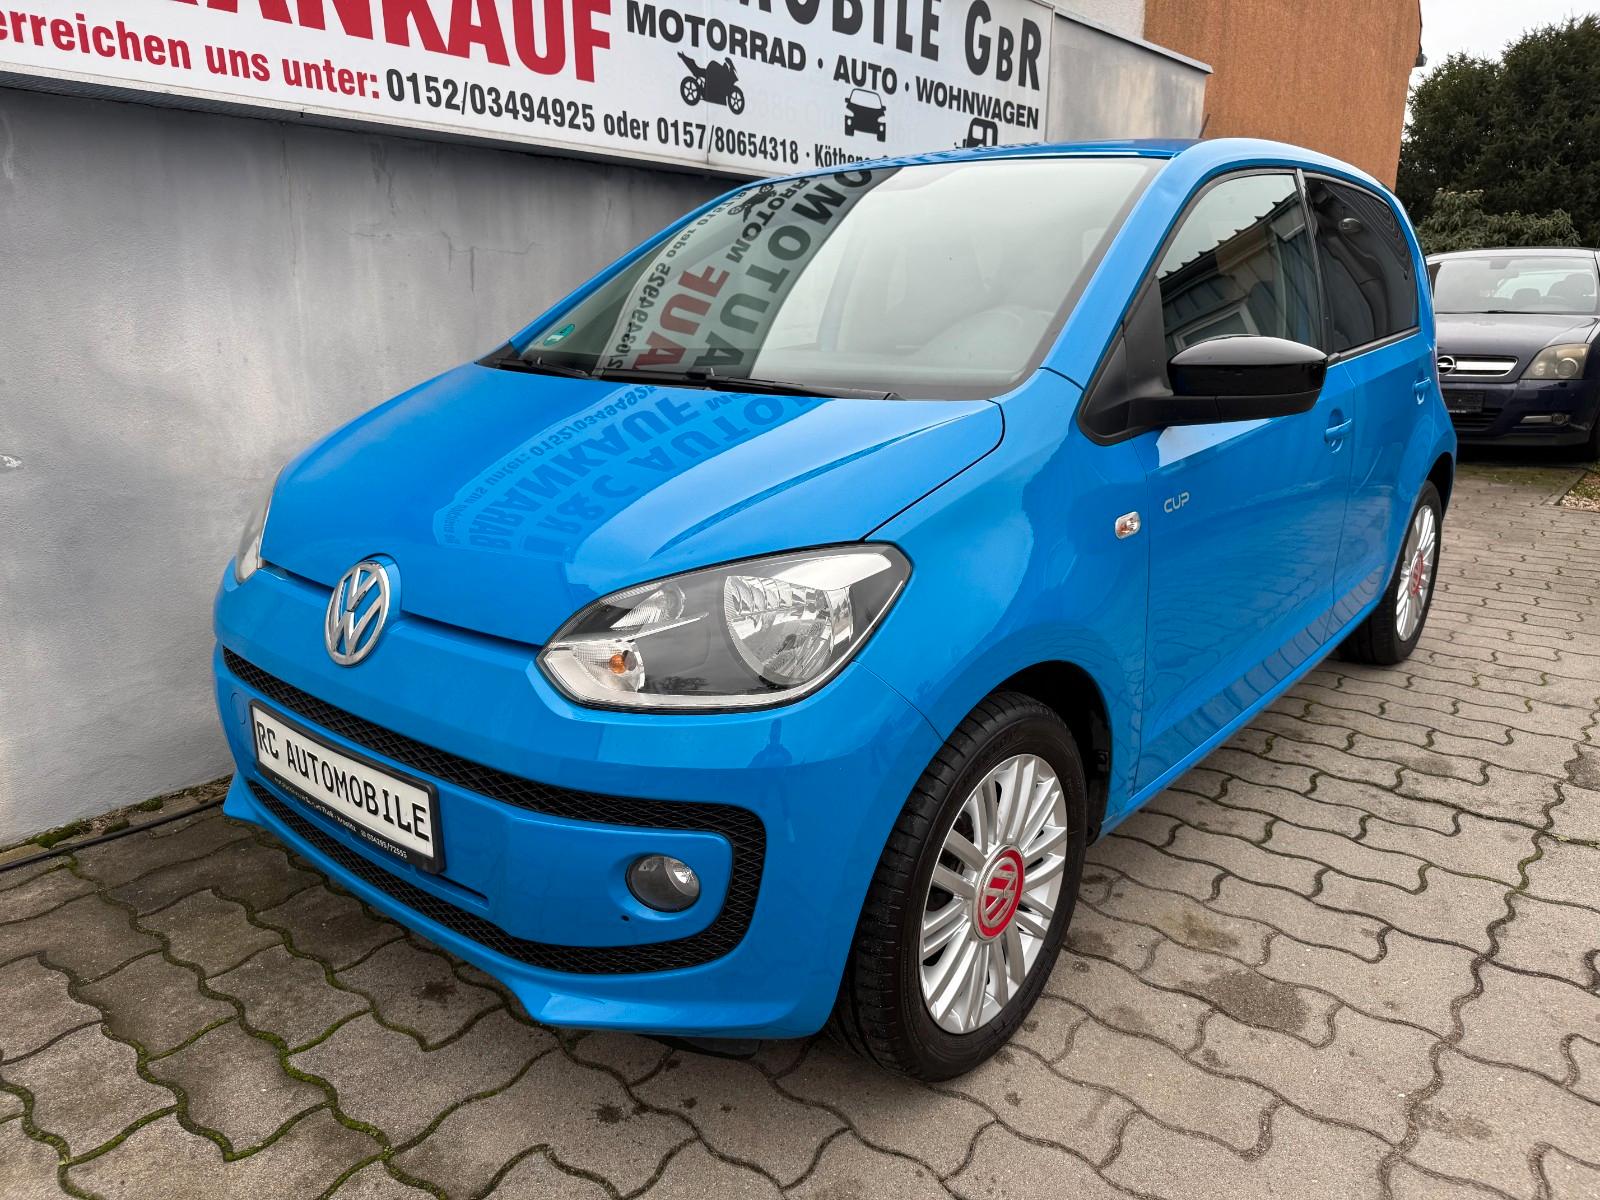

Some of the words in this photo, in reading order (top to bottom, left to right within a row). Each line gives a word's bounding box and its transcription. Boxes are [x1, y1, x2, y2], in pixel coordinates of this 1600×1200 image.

[205, 45, 270, 82] uns
[282, 50, 382, 99] unter:
[386, 68, 596, 132] 0152/03494925
[603, 110, 649, 141] oder
[657, 116, 799, 165] 0157/80654318
[627, 0, 807, 71] MOTORRAD
[833, 55, 898, 95] AUTO
[916, 75, 1039, 130] WOHNWAGEN
[1163, 491, 1190, 513] CUP
[256, 720, 280, 760] RC
[286, 739, 430, 842] AUTOMOBILE
